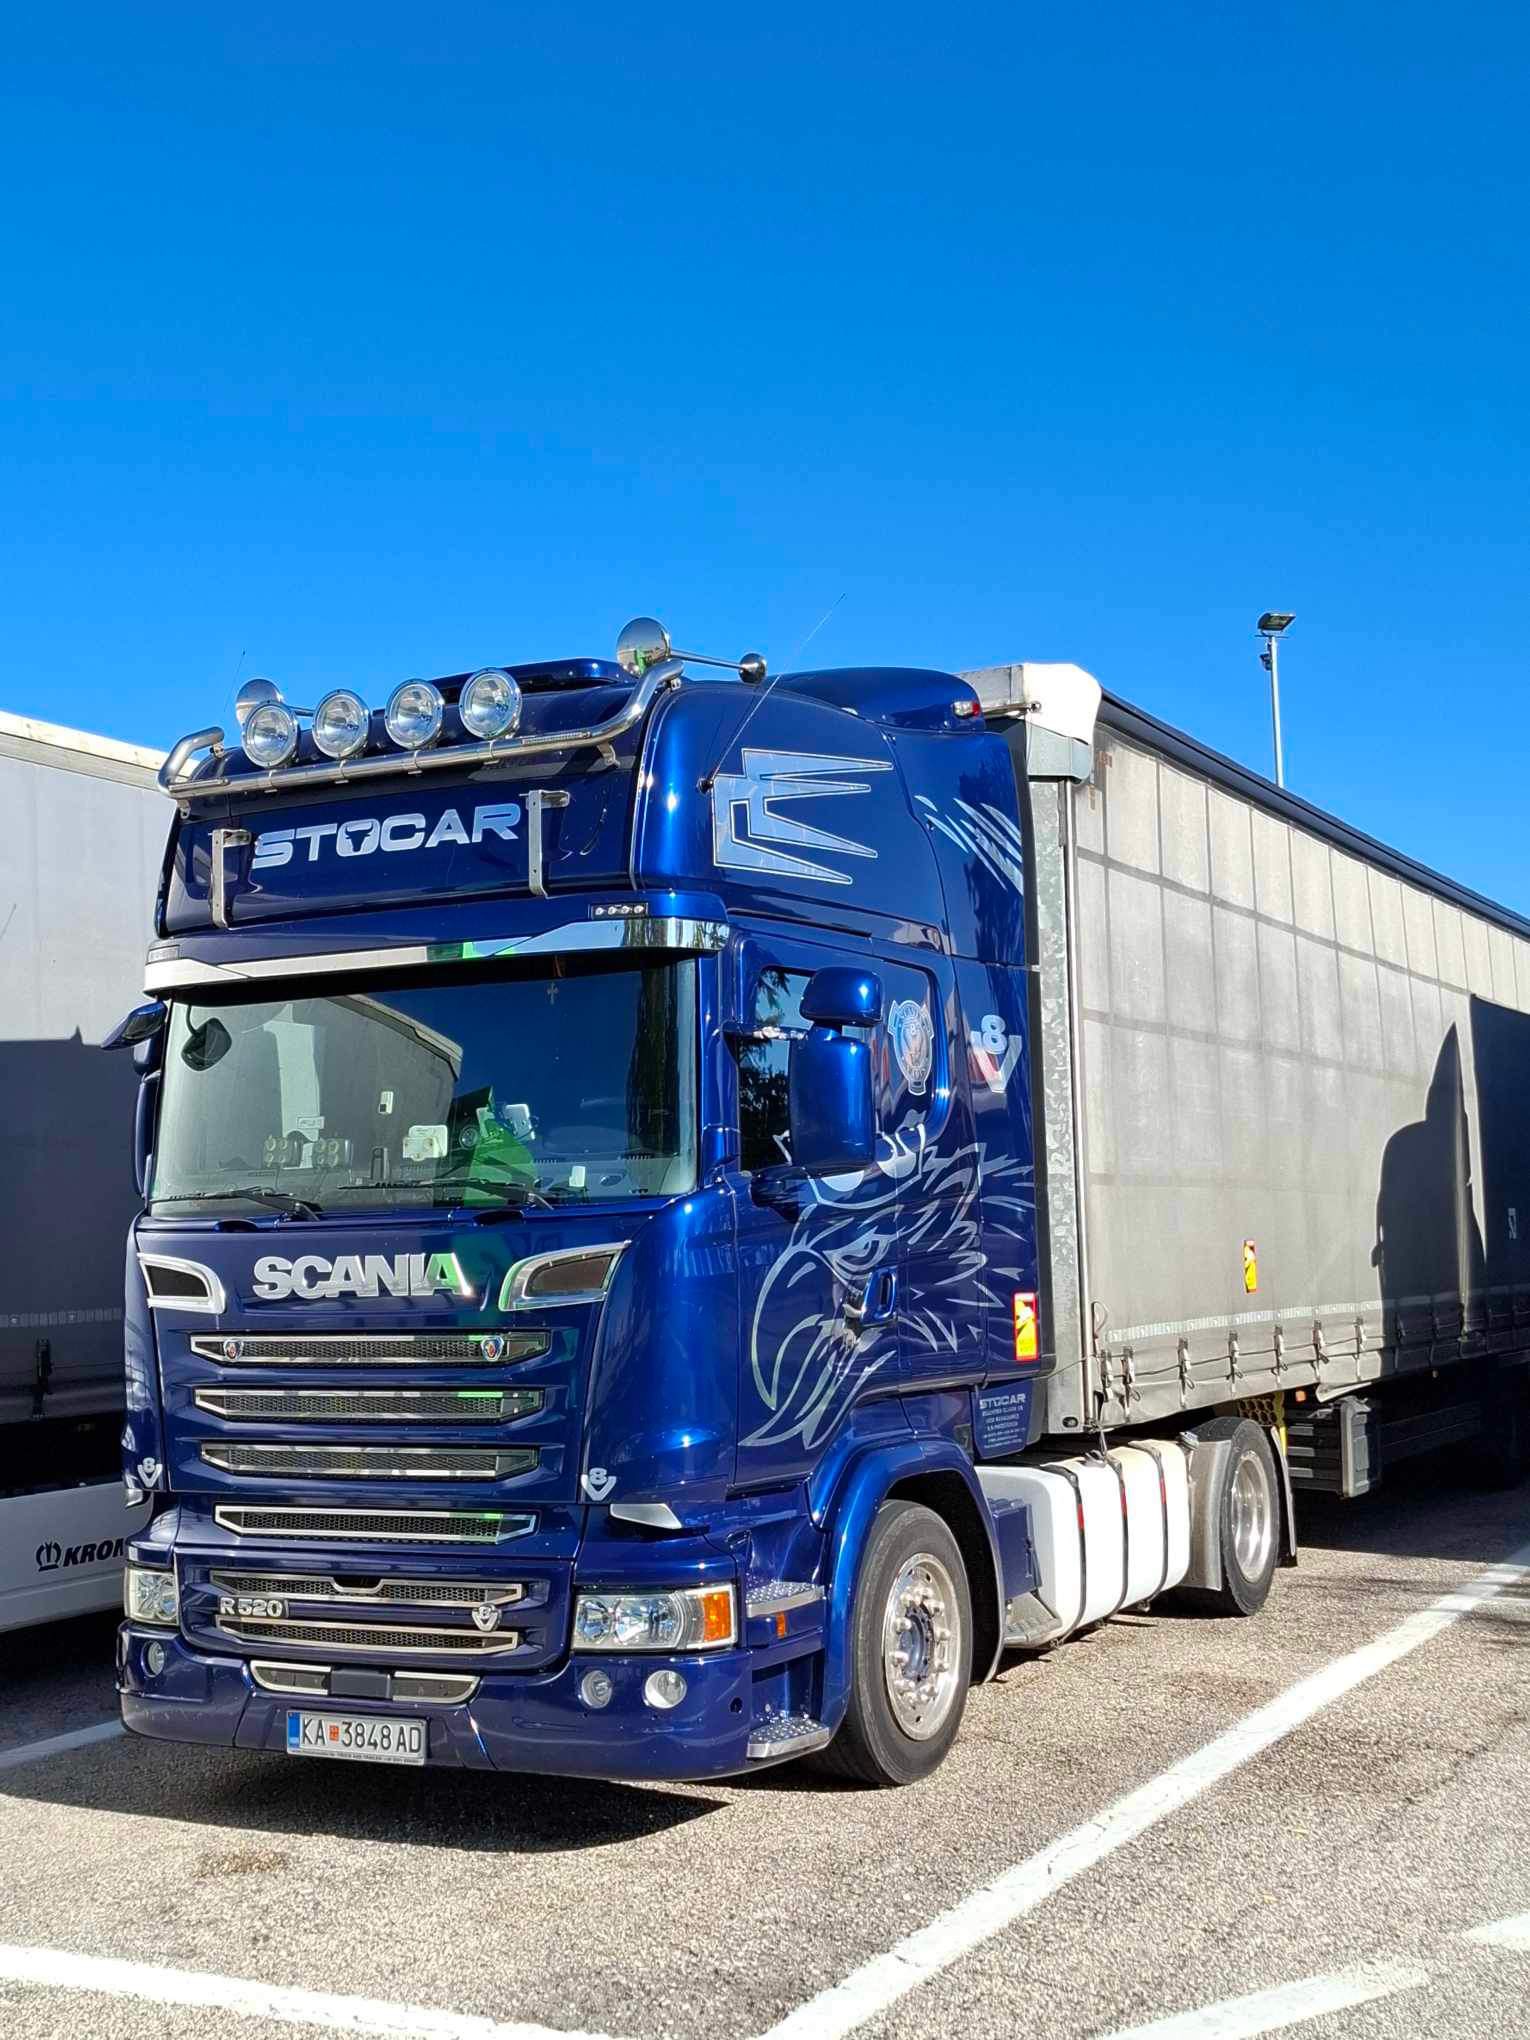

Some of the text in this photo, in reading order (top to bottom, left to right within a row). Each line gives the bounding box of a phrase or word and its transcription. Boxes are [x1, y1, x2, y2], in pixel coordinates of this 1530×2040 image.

[252, 803, 521, 869] STOCAR
[252, 1252, 472, 1300] SCANIA
[302, 1718, 327, 1745] KA
